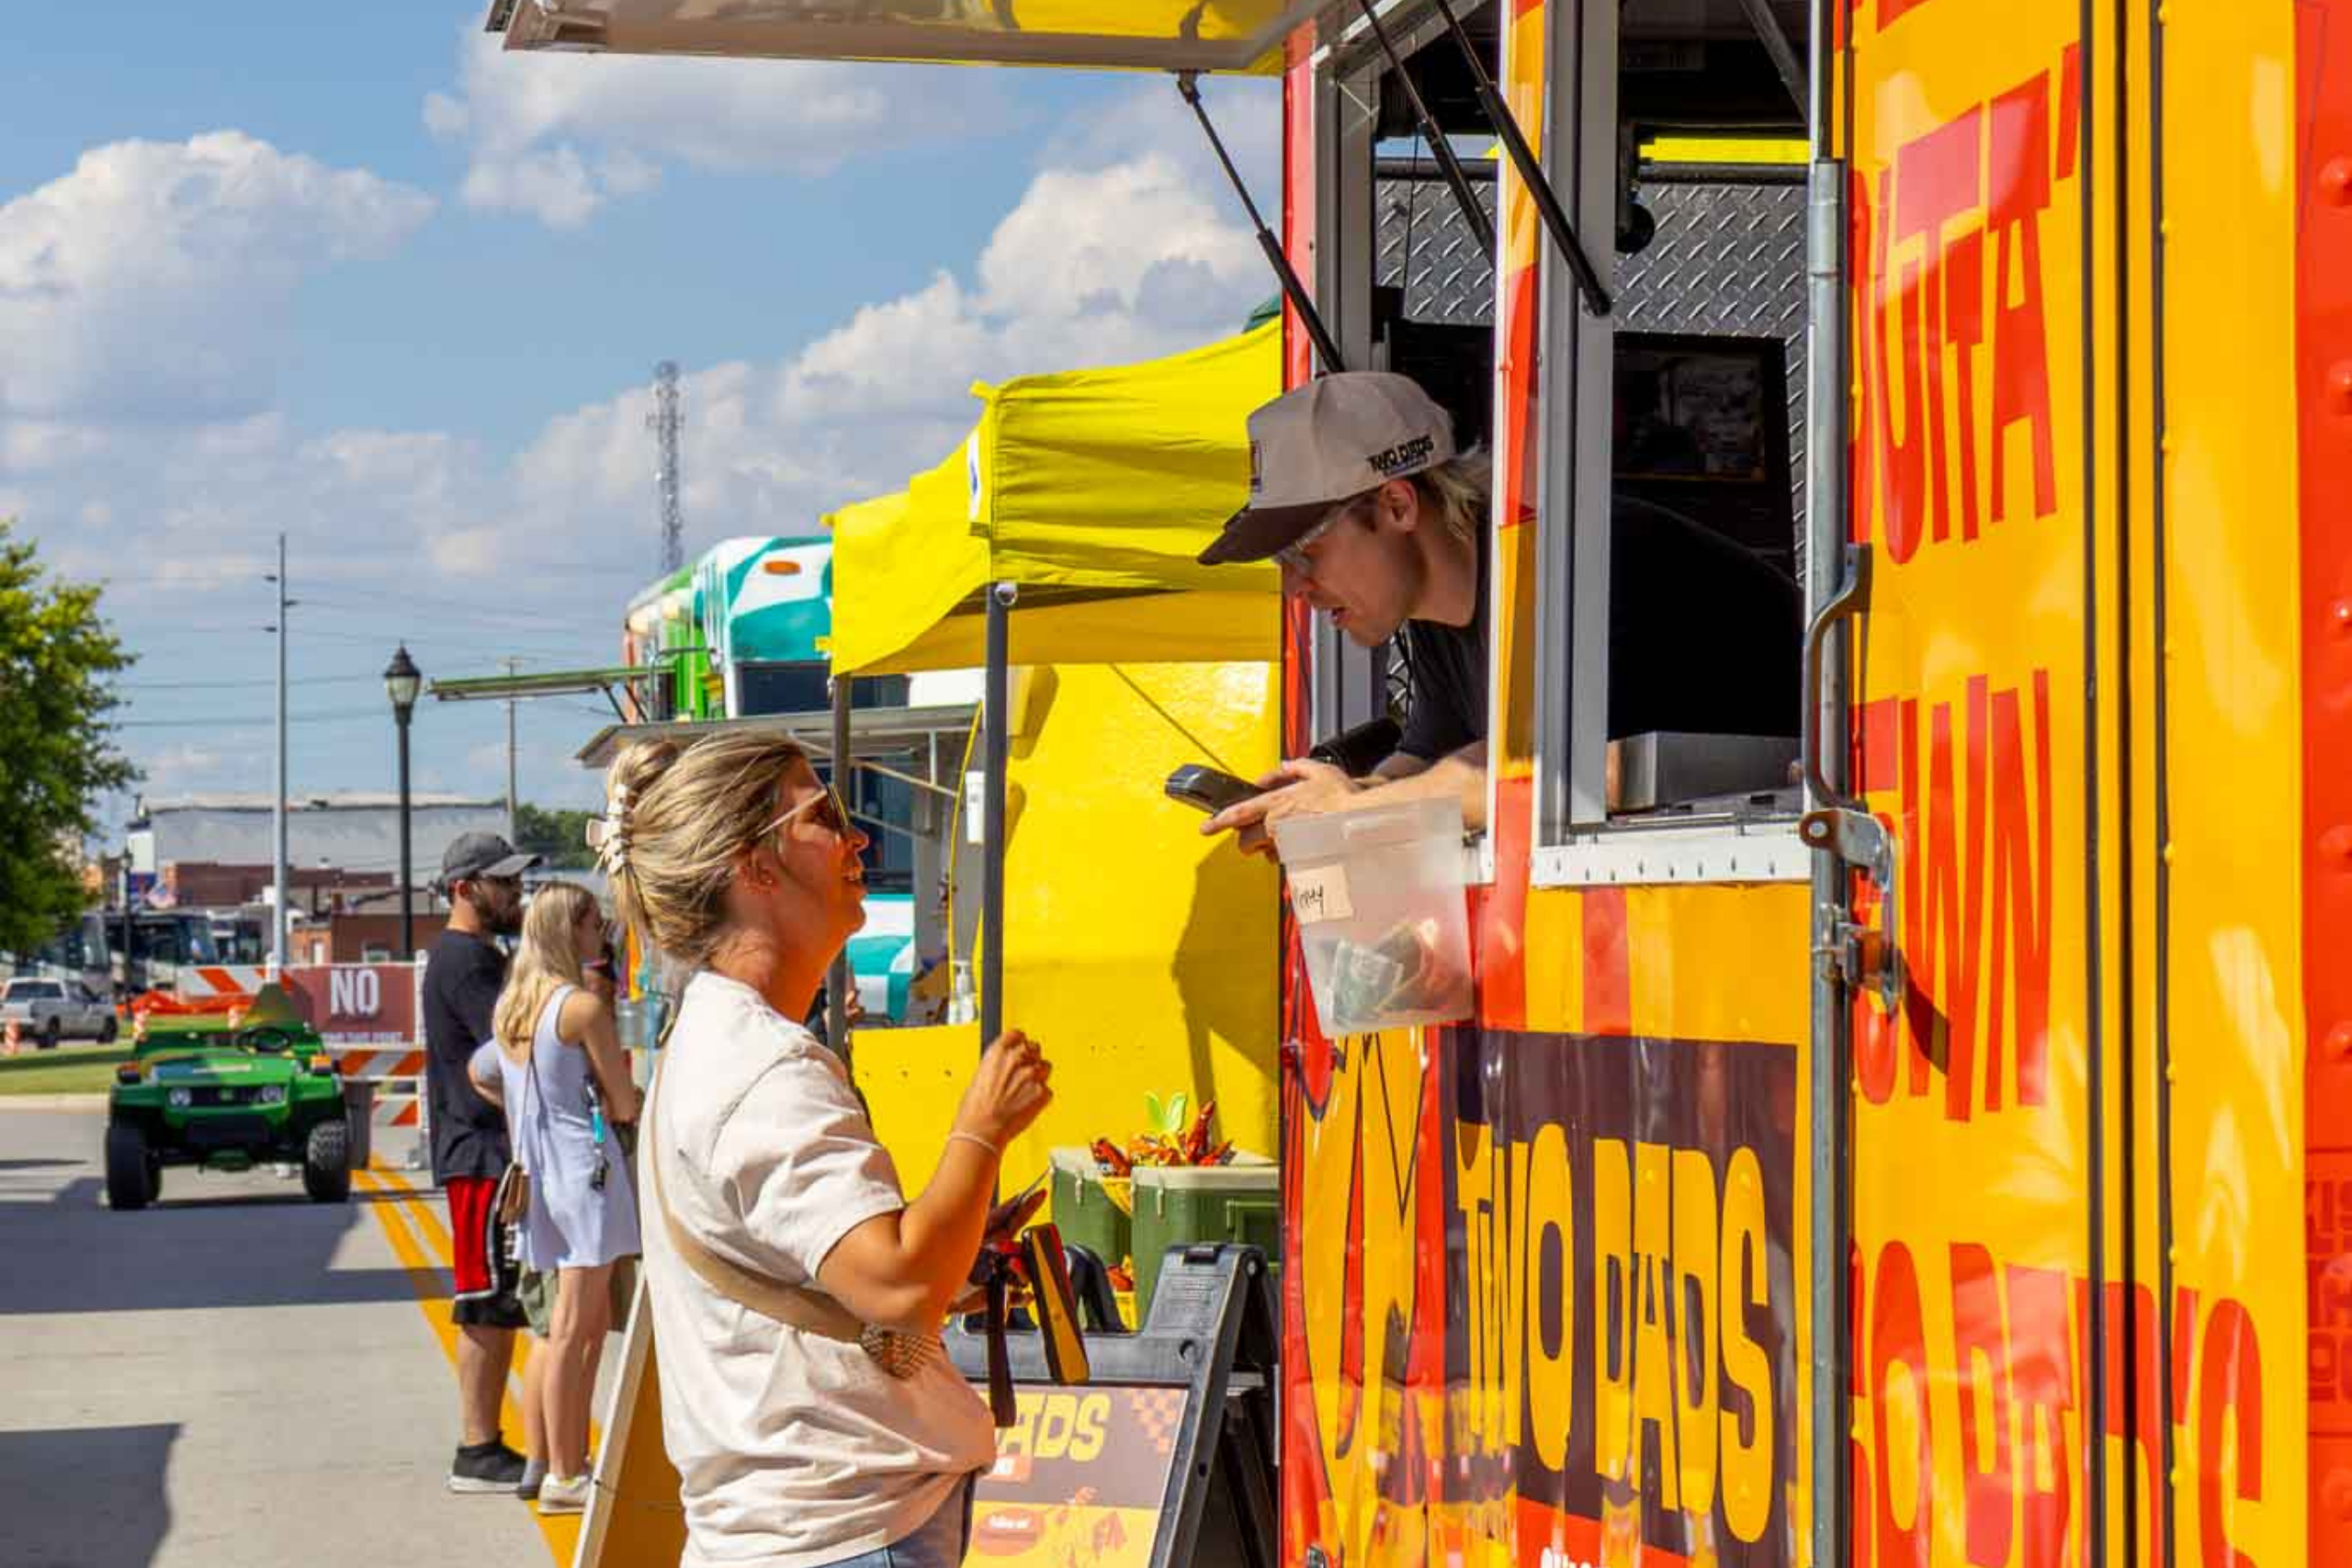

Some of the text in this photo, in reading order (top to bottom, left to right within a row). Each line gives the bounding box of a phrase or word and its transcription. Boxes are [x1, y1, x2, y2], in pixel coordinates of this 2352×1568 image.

[330, 968, 379, 1016] NO
[1455, 1122, 1774, 1543] TWO DADS
[981, 1391, 1112, 1462] ADS
